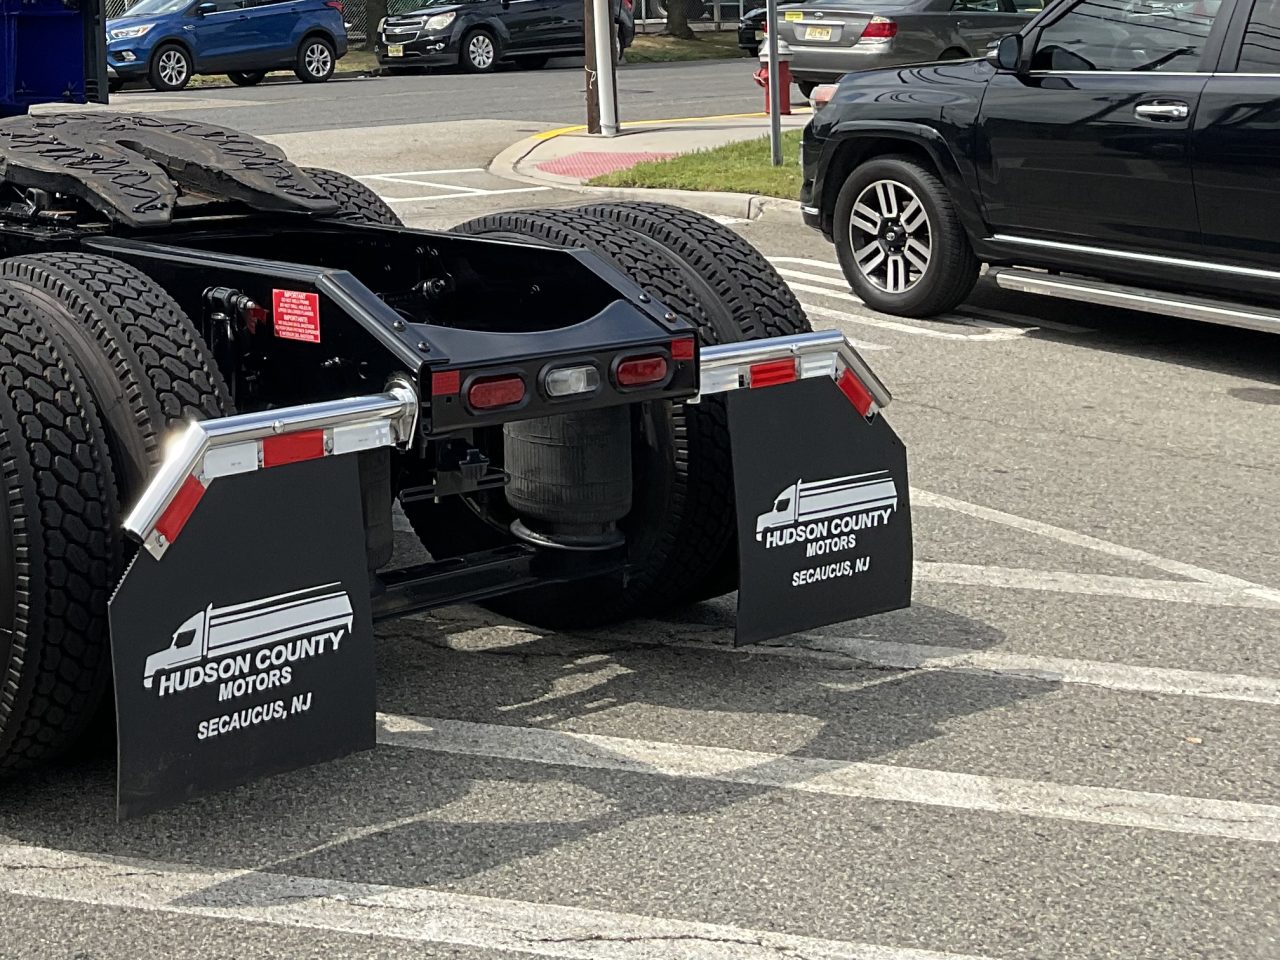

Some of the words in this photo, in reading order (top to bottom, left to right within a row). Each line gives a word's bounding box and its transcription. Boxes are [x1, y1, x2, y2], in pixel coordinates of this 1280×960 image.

[765, 521, 828, 549] HUDSON
[831, 508, 892, 533] COUNTY
[806, 534, 856, 557] MOTORS
[792, 560, 853, 587] SECAUCUS,
[855, 556, 870, 572] NJ
[158, 653, 251, 696] HUDSON
[255, 629, 345, 670] COUNTY
[218, 666, 292, 701] MOTORS
[197, 700, 287, 740] SECAUCUS,
[290, 692, 312, 715] NJ
